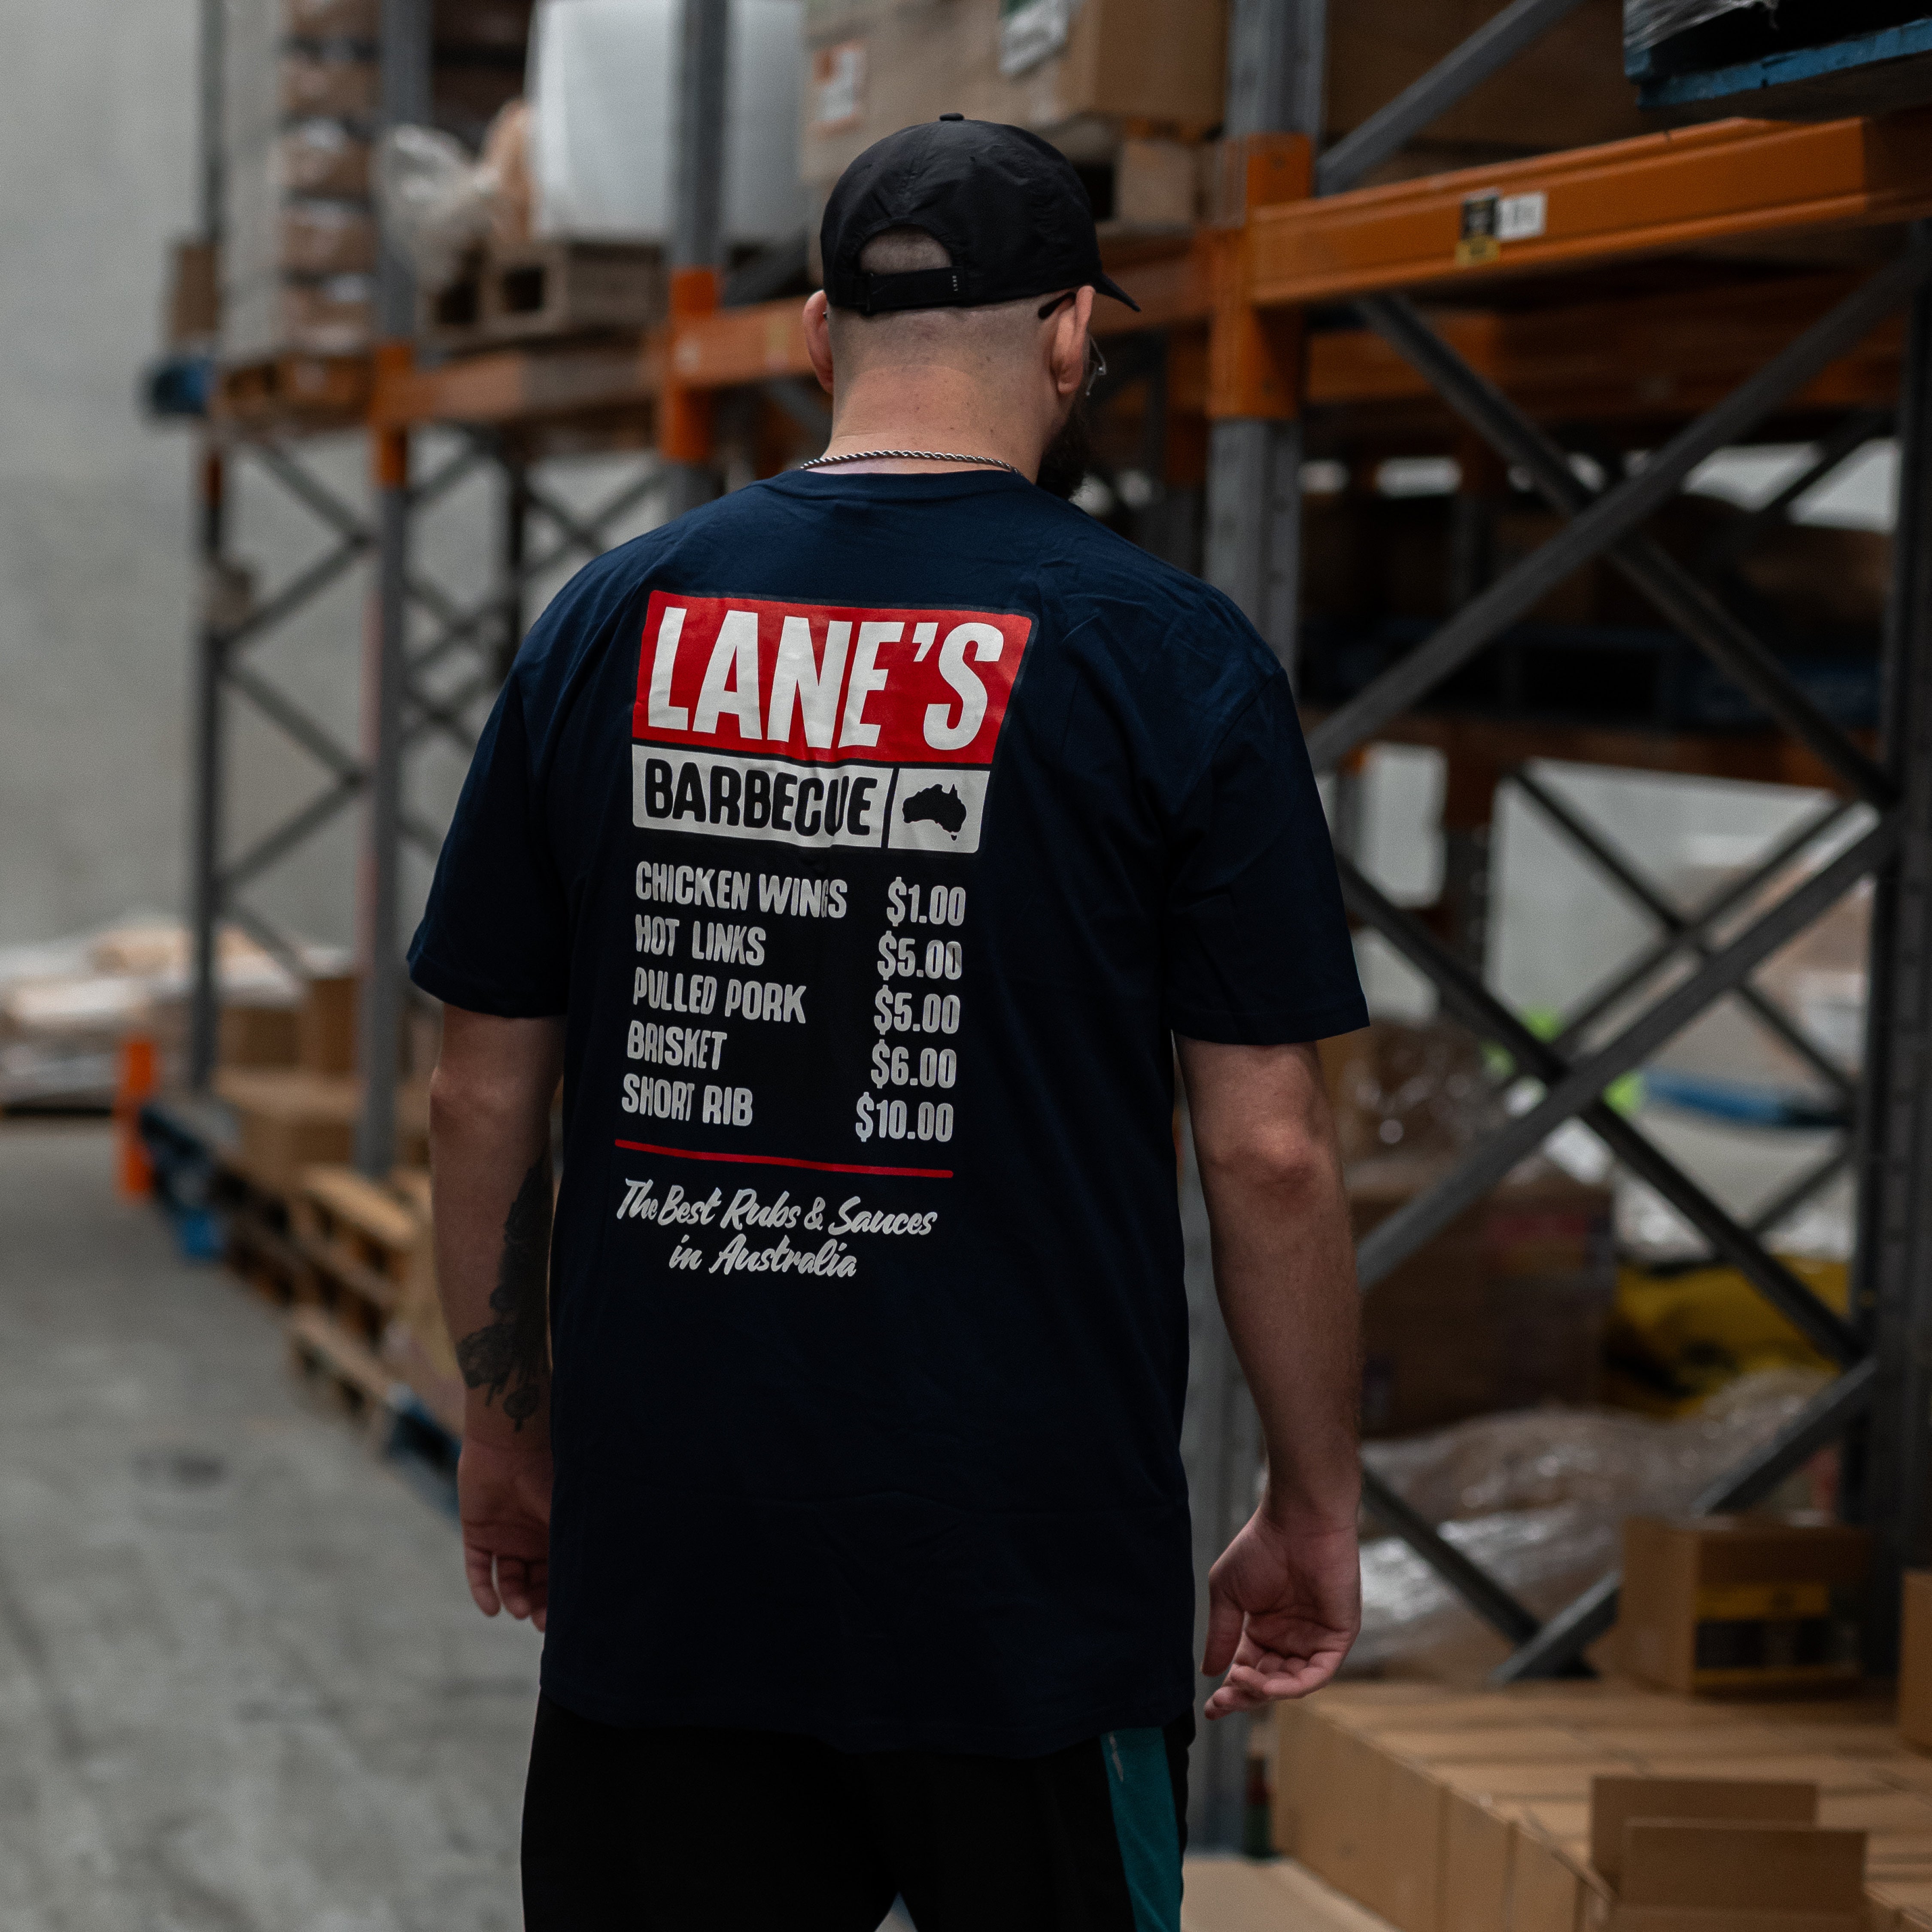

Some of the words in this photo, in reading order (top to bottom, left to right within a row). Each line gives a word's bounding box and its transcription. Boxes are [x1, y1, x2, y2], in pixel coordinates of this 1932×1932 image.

[648, 606, 1004, 750] LANE'S
[645, 758, 878, 837] BARBECUE
[636, 861, 750, 911] CHICKEN
[759, 873, 848, 918] WINGS
[887, 876, 966, 927] $1.00
[635, 914, 680, 957] HOT
[692, 921, 766, 966] LINKS
[877, 930, 962, 981] $5.00
[633, 967, 717, 1015] PULLED
[724, 979, 807, 1024] PORK
[874, 984, 960, 1035] $5.00
[627, 1020, 727, 1070] BRISKET
[871, 1039, 957, 1089] $6.00
[622, 1073, 695, 1121] SHORT
[702, 1085, 753, 1127] RIB
[855, 1091, 954, 1142] $10.00
[617, 1178, 658, 1220] The
[657, 1185, 722, 1226] Best
[720, 1188, 801, 1230] Rubs
[804, 1197, 826, 1231] &
[828, 1196, 938, 1236] Sauces
[669, 1234, 702, 1270] in
[708, 1233, 857, 1278] Australia
